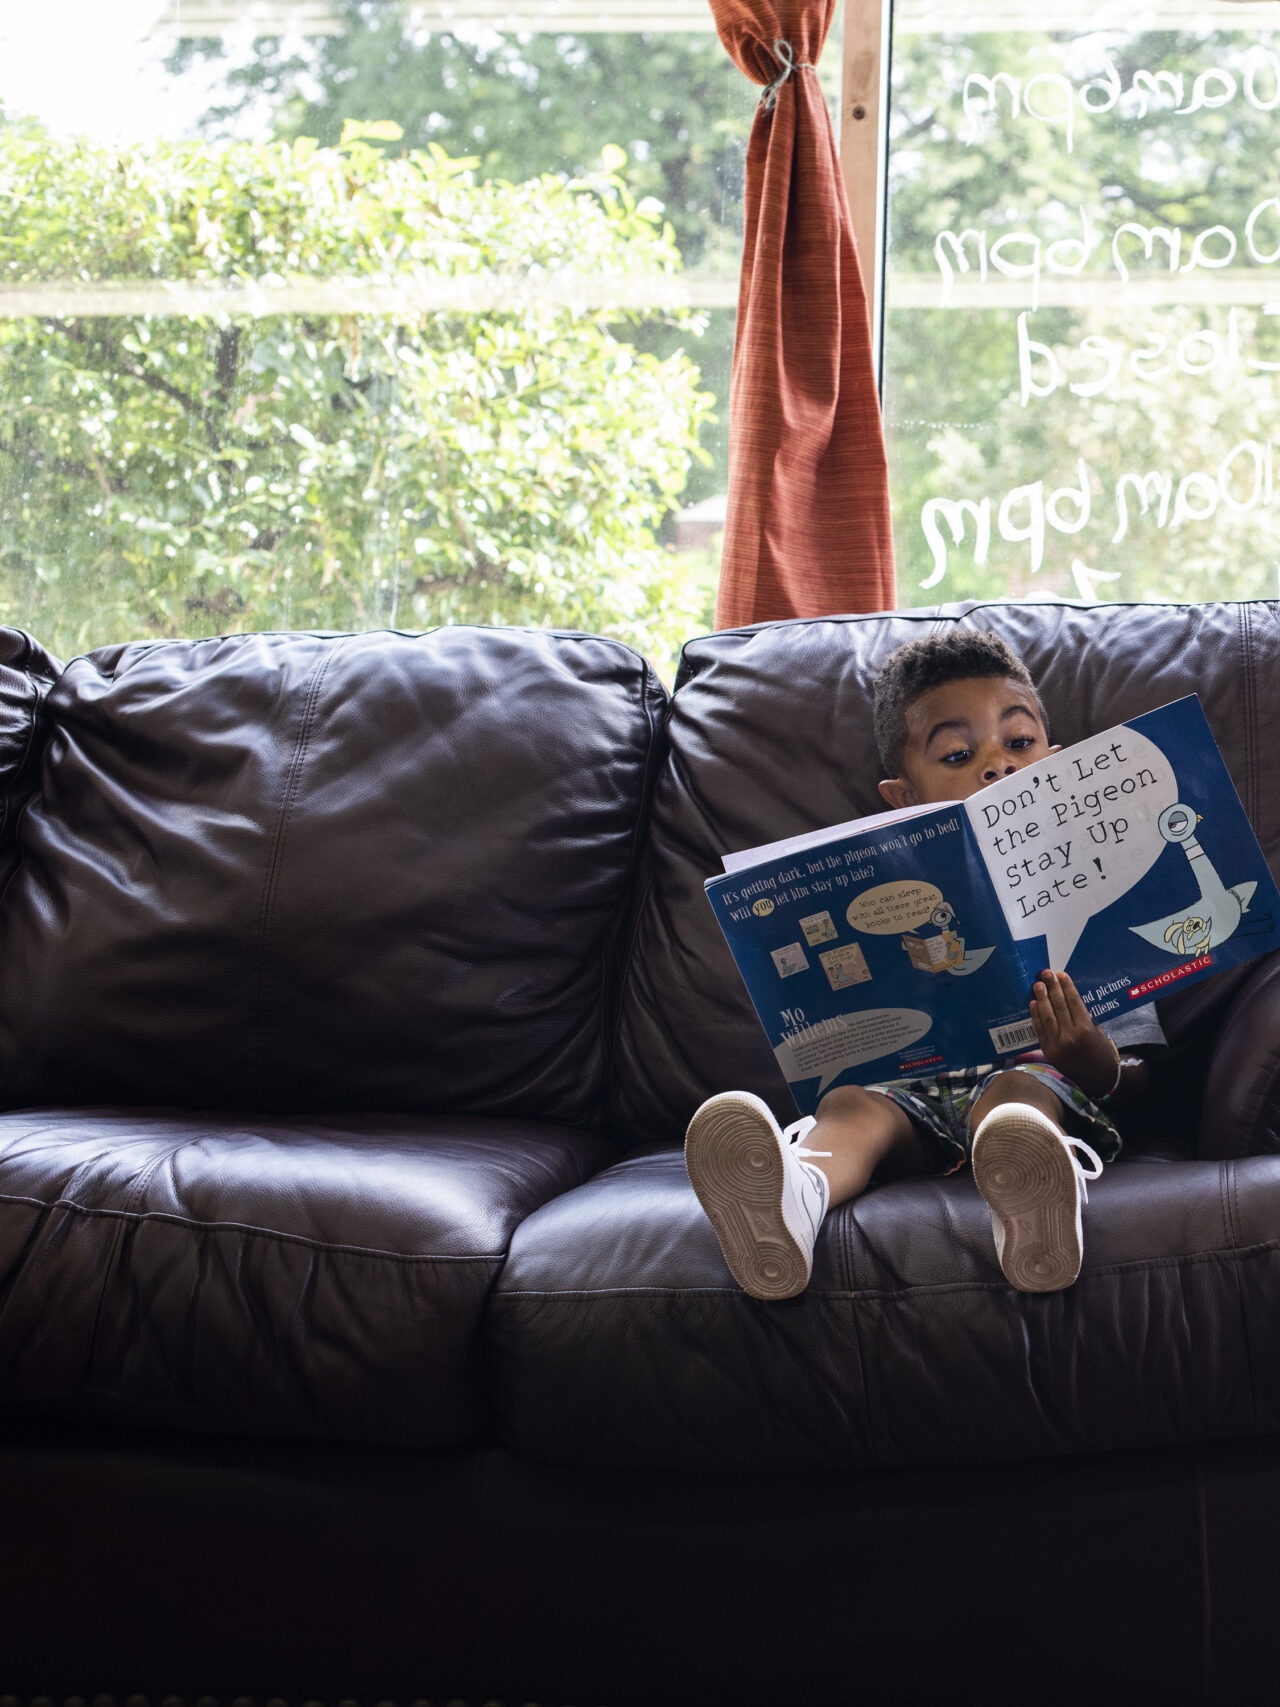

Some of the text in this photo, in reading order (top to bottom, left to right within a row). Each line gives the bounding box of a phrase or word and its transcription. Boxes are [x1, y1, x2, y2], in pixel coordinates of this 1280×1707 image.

[981, 742, 1128, 829] Don't Let
[992, 766, 1158, 857] the Pigeon
[741, 877, 777, 900] getting
[806, 859, 825, 874] but
[825, 855, 843, 868] the
[844, 846, 878, 866] pigeon
[879, 834, 908, 853] won't
[909, 832, 923, 847] go
[924, 827, 935, 840] to
[1005, 815, 1129, 889] Stay Up
[753, 900, 773, 915] you
[774, 891, 790, 906] let
[790, 886, 810, 901] him
[810, 879, 833, 894] stay
[835, 874, 849, 887] up
[850, 865, 875, 882] late?
[1095, 975, 1132, 1001] pictures
[1140, 957, 1211, 993] SCHOLASTIC
